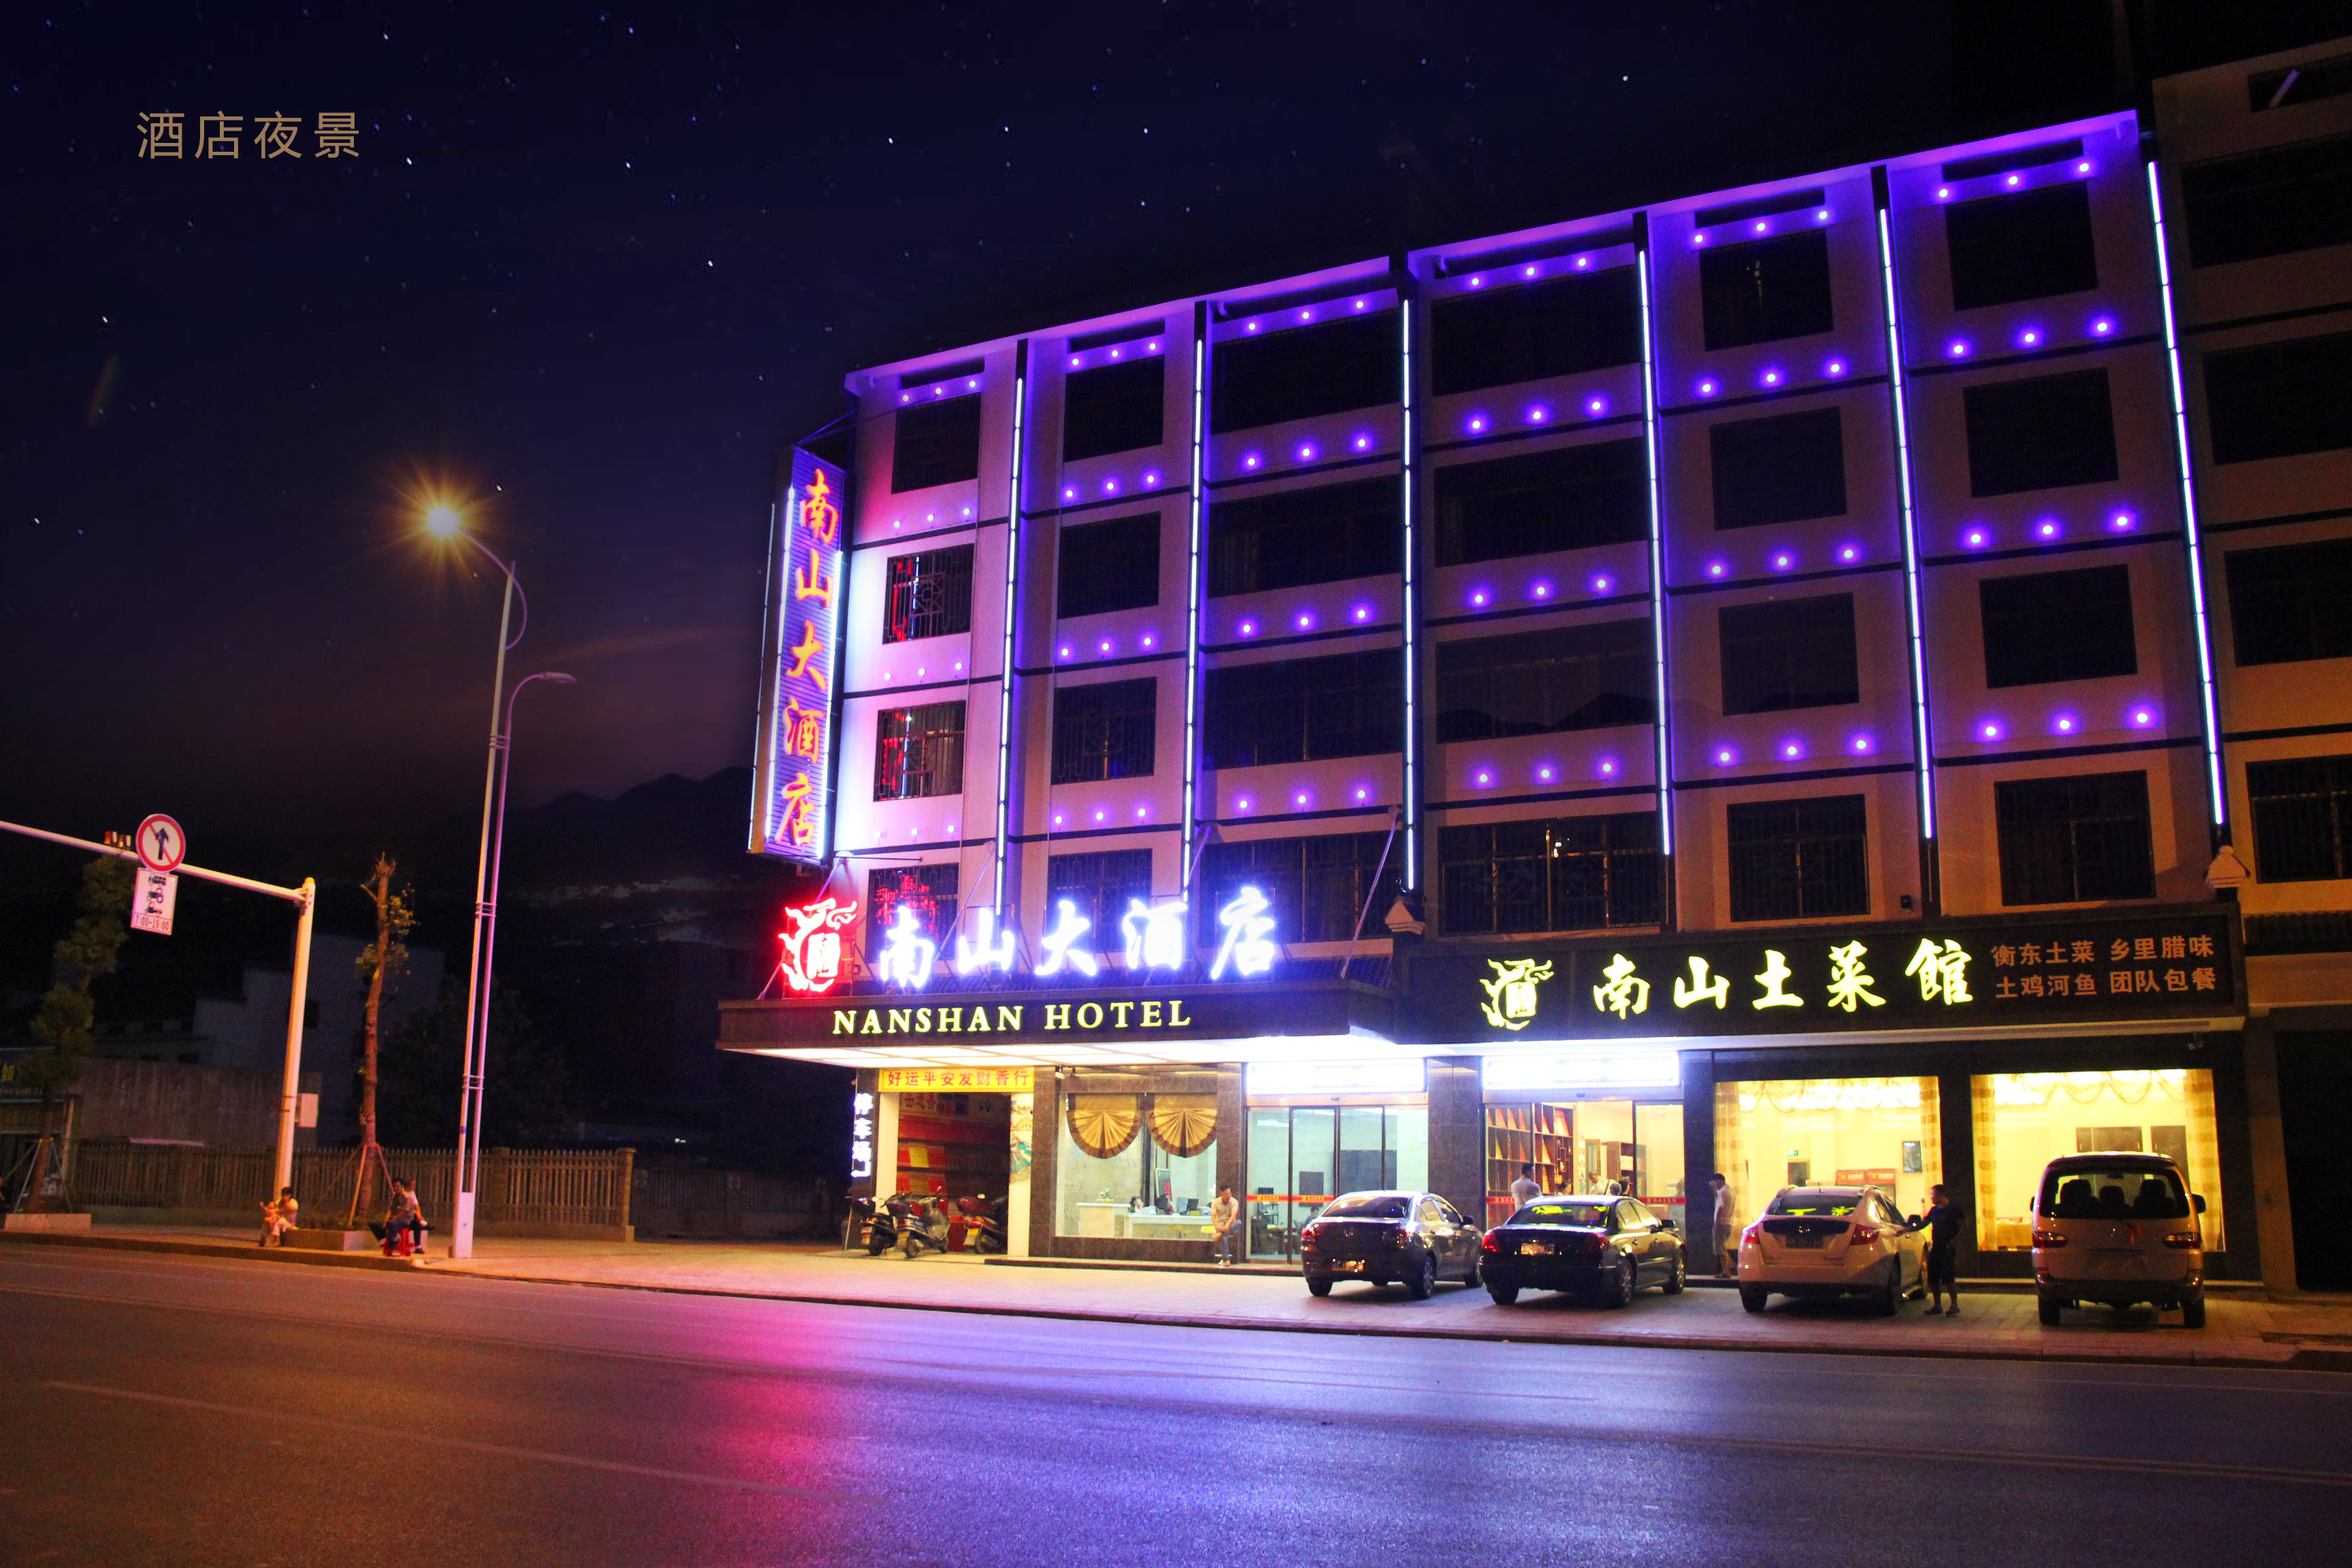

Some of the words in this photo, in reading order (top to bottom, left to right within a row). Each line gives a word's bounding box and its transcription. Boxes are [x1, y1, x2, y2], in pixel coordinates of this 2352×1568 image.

[774, 468, 840, 847] 南山大酒店
[879, 886, 1276, 989] 南山大酒店
[1990, 940, 2095, 967] 衡东土菜
[2110, 934, 2214, 961] 乡里腊味
[1592, 938, 1974, 1019] 南山土菜館
[1995, 973, 2097, 998] 土鸡河鱼
[2110, 967, 2216, 994] 团队包餐
[832, 1005, 1023, 1034] NANSHAN
[1044, 1000, 1192, 1029] HOTEL
[887, 1070, 1029, 1087] 好运平安发财香行
